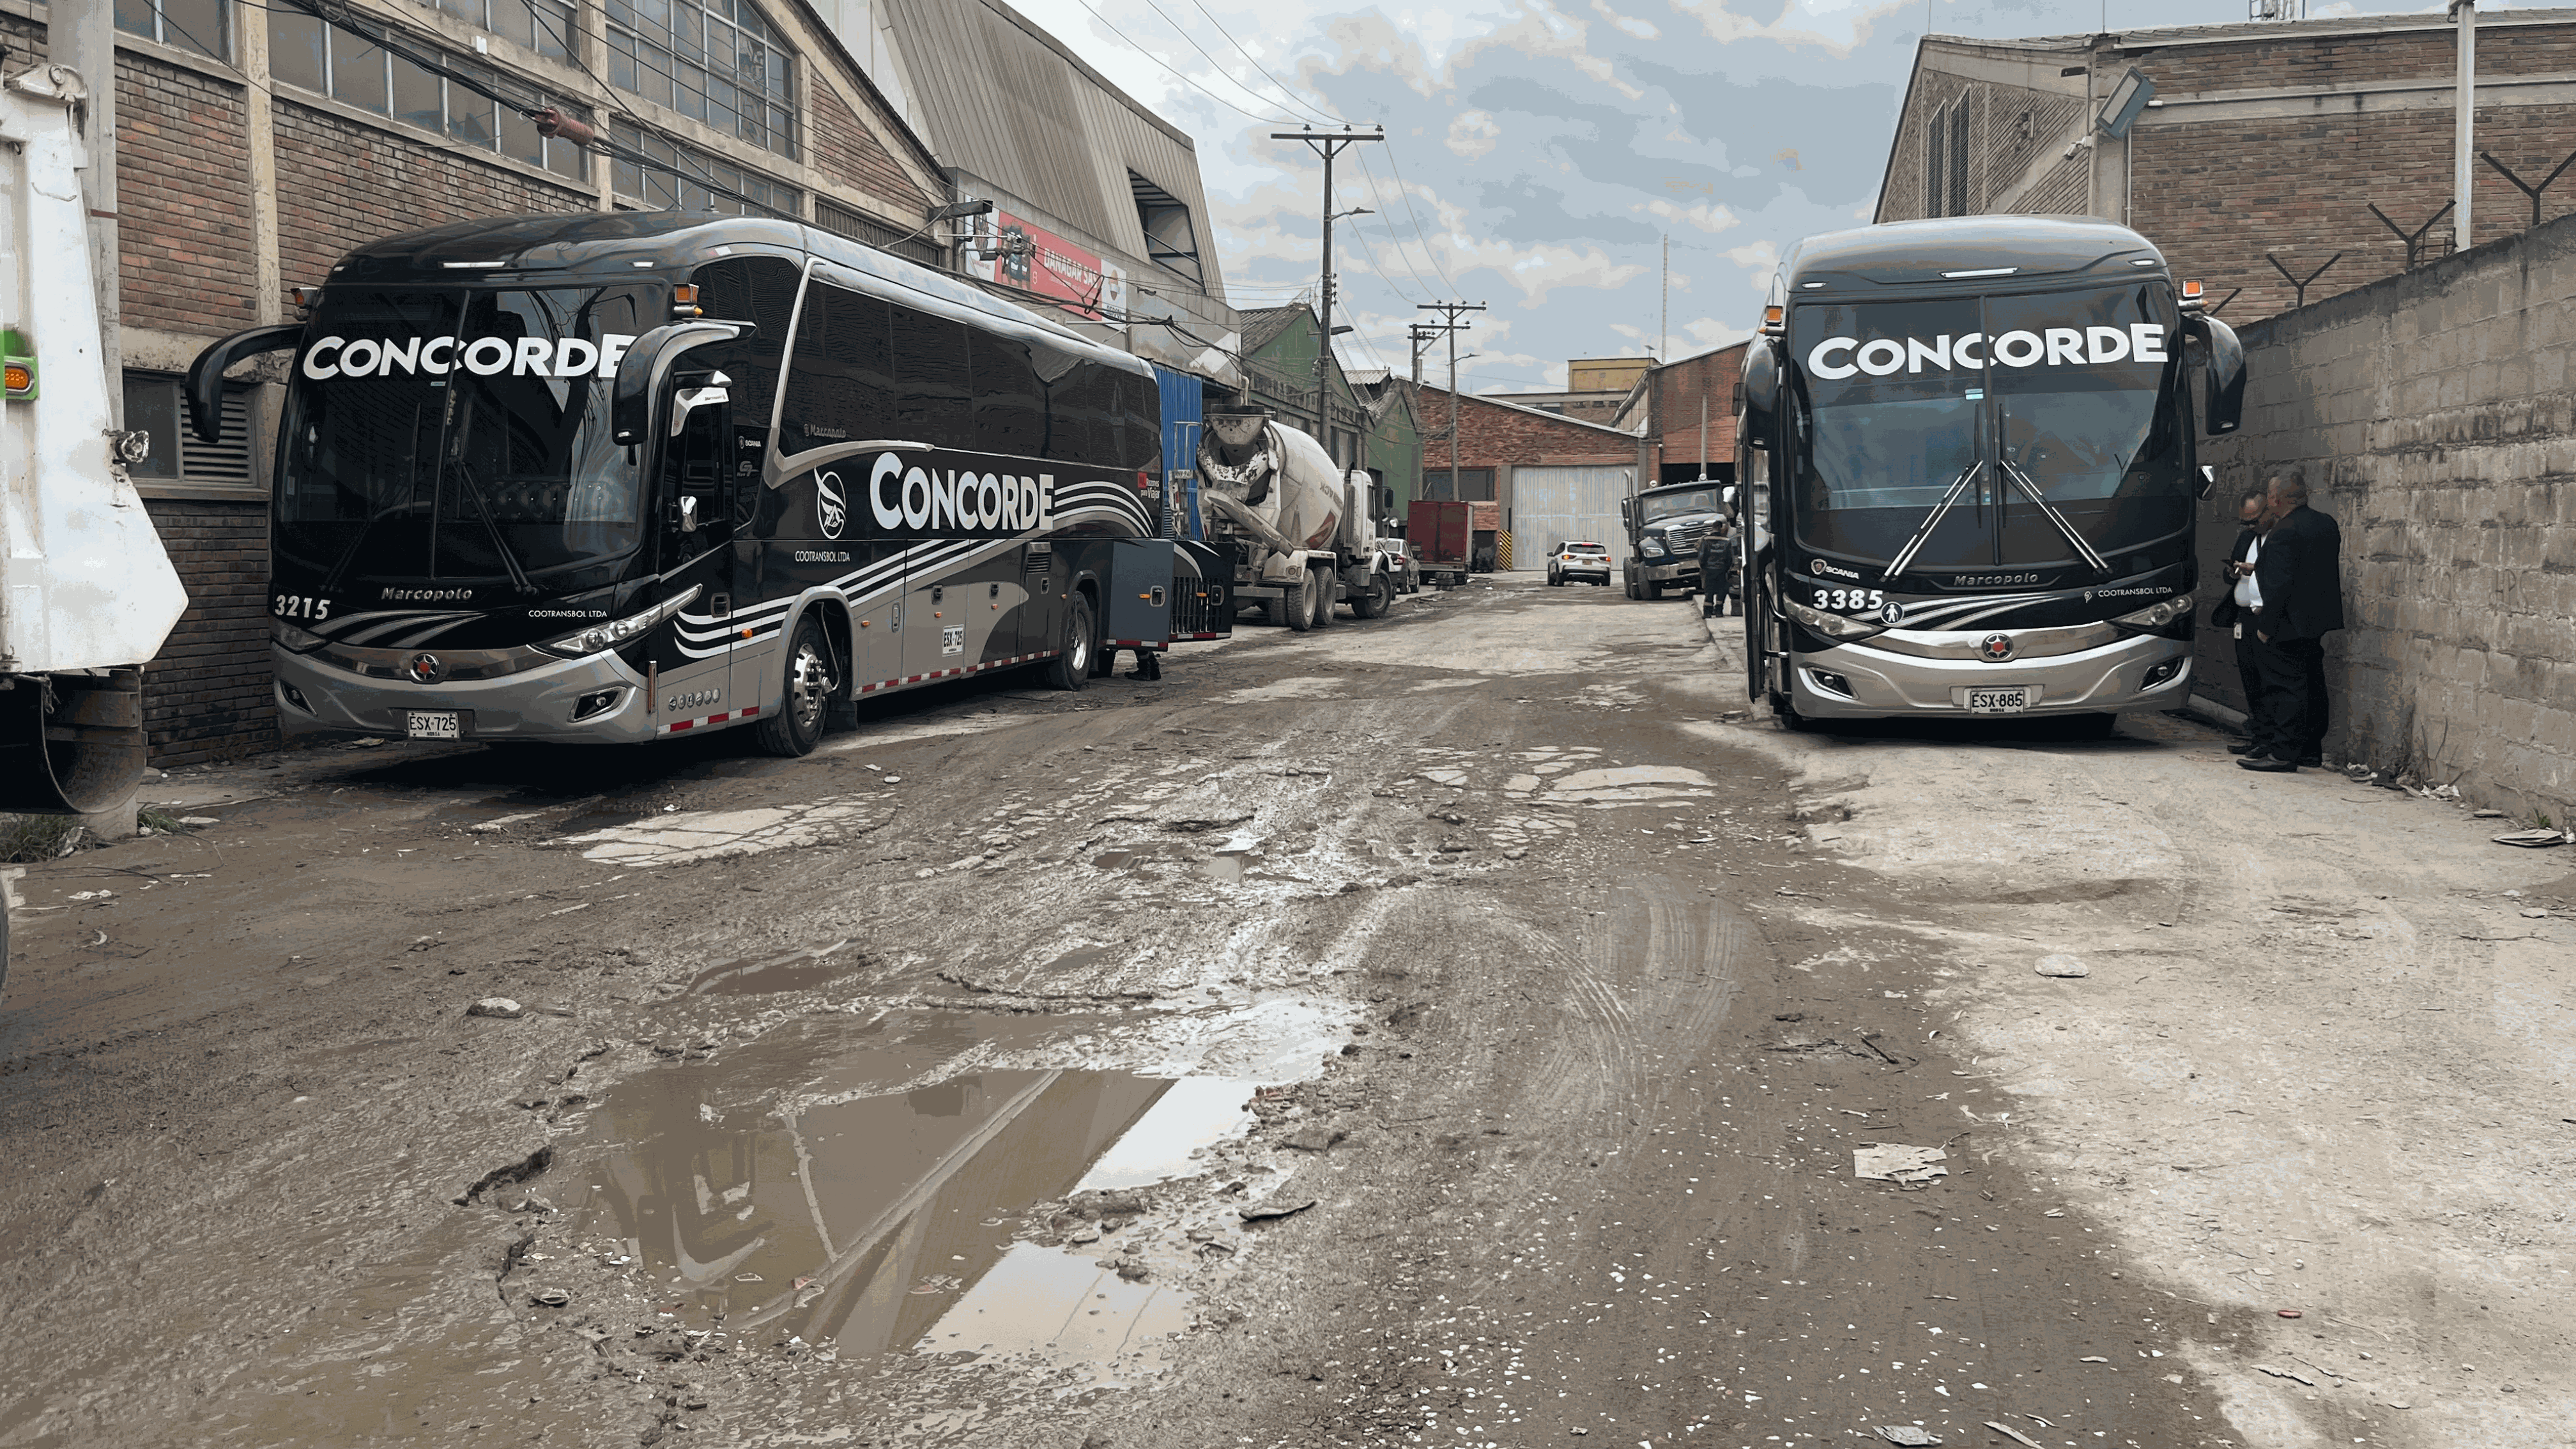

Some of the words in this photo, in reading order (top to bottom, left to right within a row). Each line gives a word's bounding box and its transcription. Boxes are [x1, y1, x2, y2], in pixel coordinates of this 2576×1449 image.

[303, 334, 638, 380] CONCORDE
[1808, 323, 2168, 379] CONCORDE
[809, 424, 847, 438] Marcopolo
[870, 452, 1054, 530] CONCORDE
[795, 551, 836, 562] COOTRANSBOL
[838, 551, 850, 562] LTDA
[1825, 566, 1859, 579] SCANIA
[1954, 573, 2038, 586] Marcopolo
[381, 587, 472, 601] Marcopolo
[2097, 587, 2154, 597] COOTRANSBOL
[1813, 589, 1883, 610] 3385
[275, 594, 331, 620] 3215
